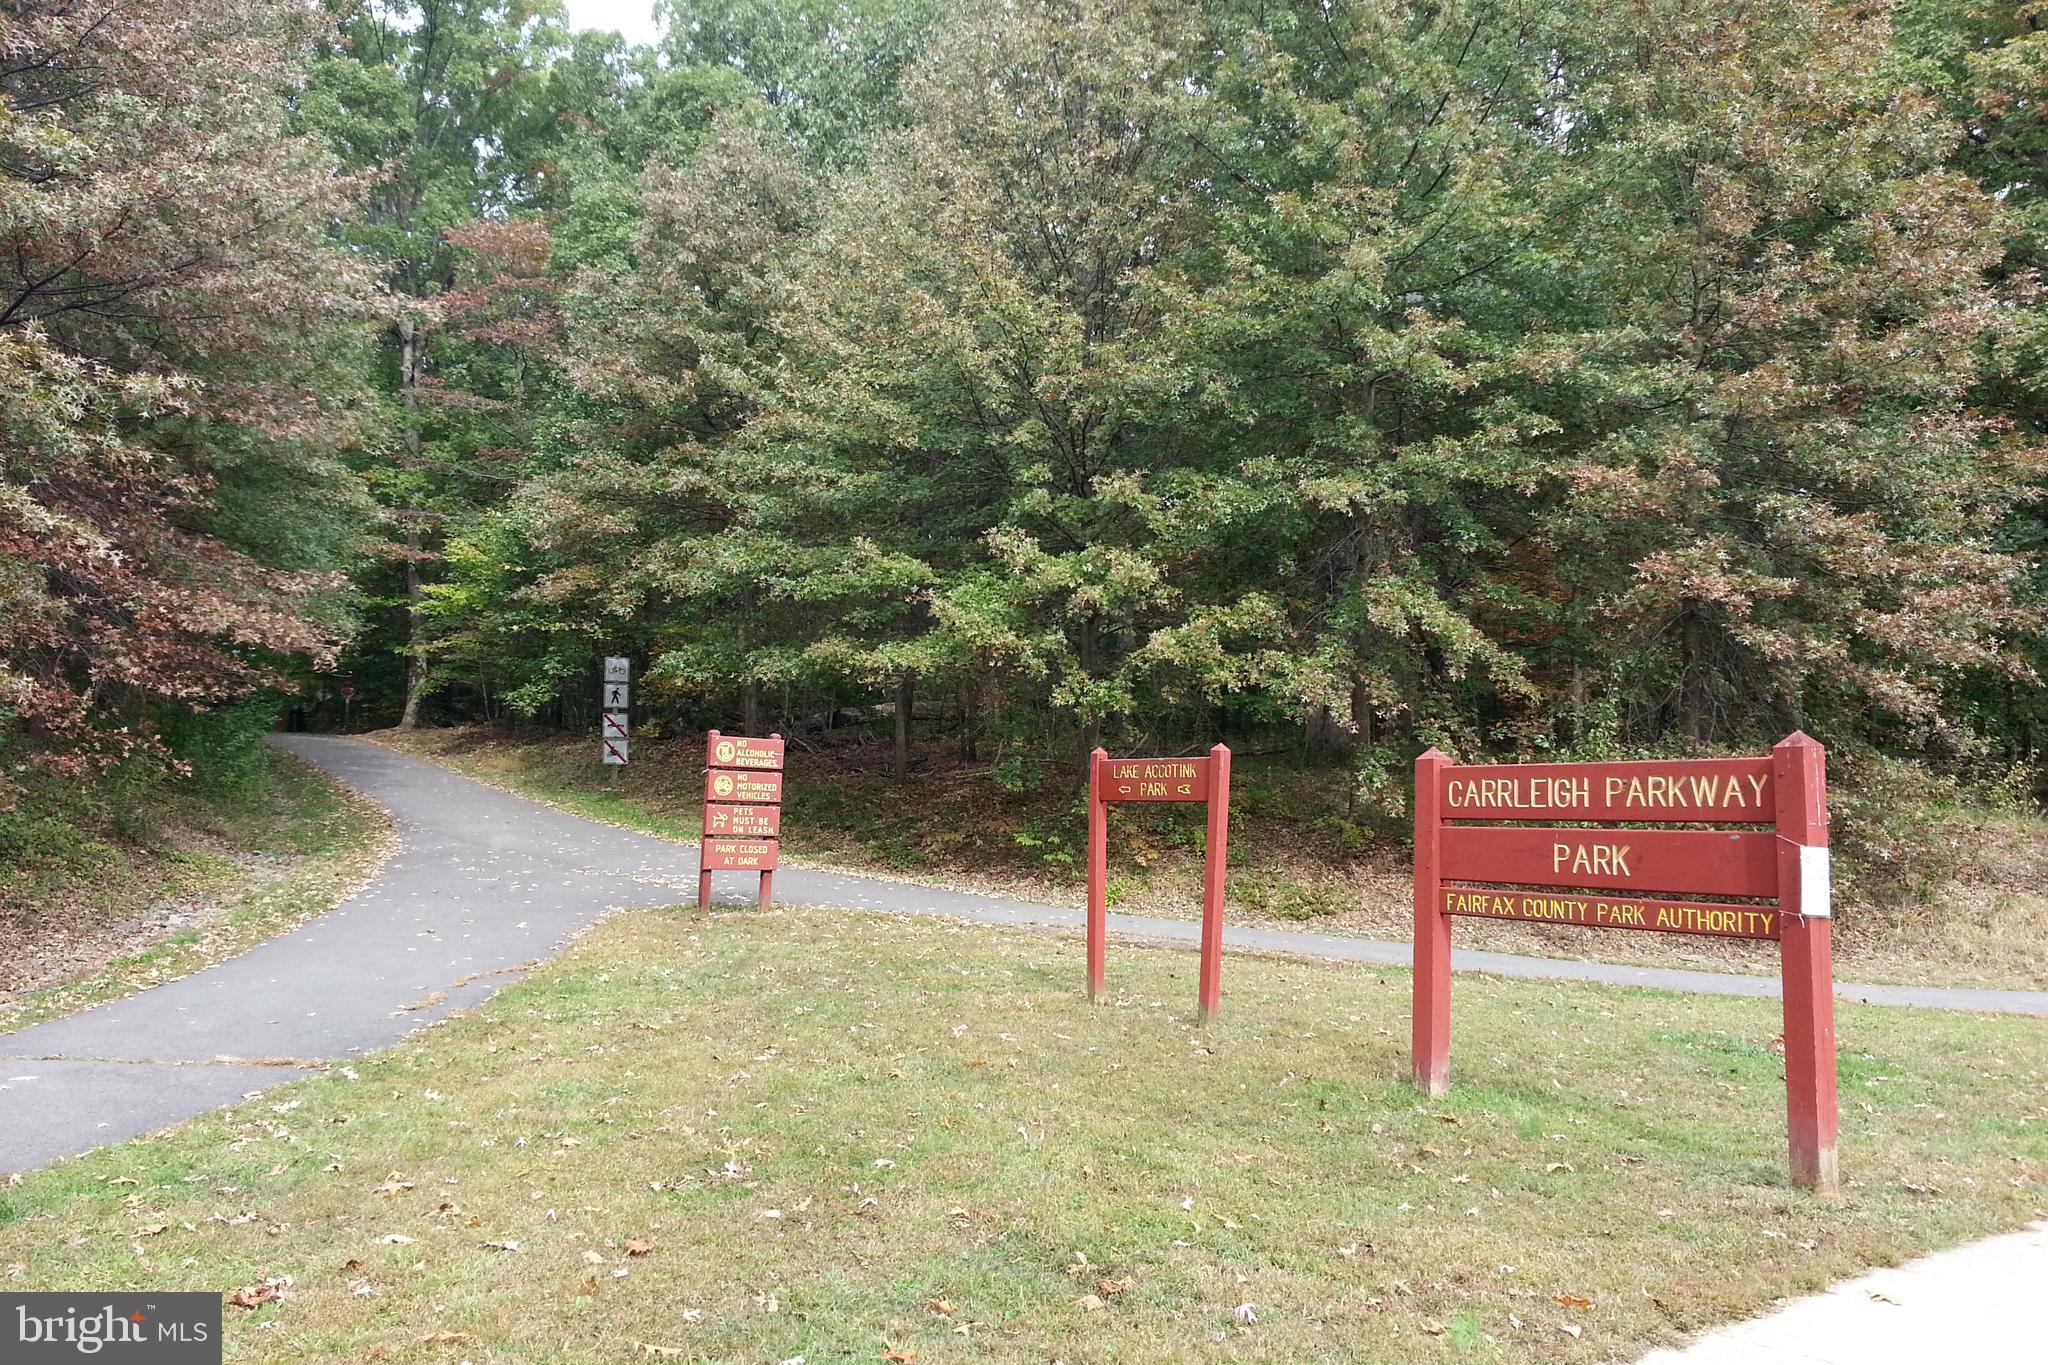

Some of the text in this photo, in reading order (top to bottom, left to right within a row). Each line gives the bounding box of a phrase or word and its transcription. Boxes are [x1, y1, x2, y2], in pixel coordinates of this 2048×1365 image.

[736, 740, 747, 748] NO
[736, 749, 774, 758] ALCOHOLIC
[1114, 764, 1196, 778] LAKE ACCOTINK
[737, 782, 777, 791] MOTORIZED
[1140, 782, 1168, 796] PARK
[1448, 773, 1768, 808] CARRLEIGH PARKWAY
[737, 792, 770, 800] VEHICLES
[732, 817, 768, 826] MUST BE
[732, 826, 774, 834] ON LEASH
[716, 844, 768, 854] PARK CLOSED
[724, 856, 758, 866] AT DARK
[1553, 843, 1630, 877] PARK
[1446, 892, 1774, 934] FAIRFAX COUNTY PARK AUTHORITY
